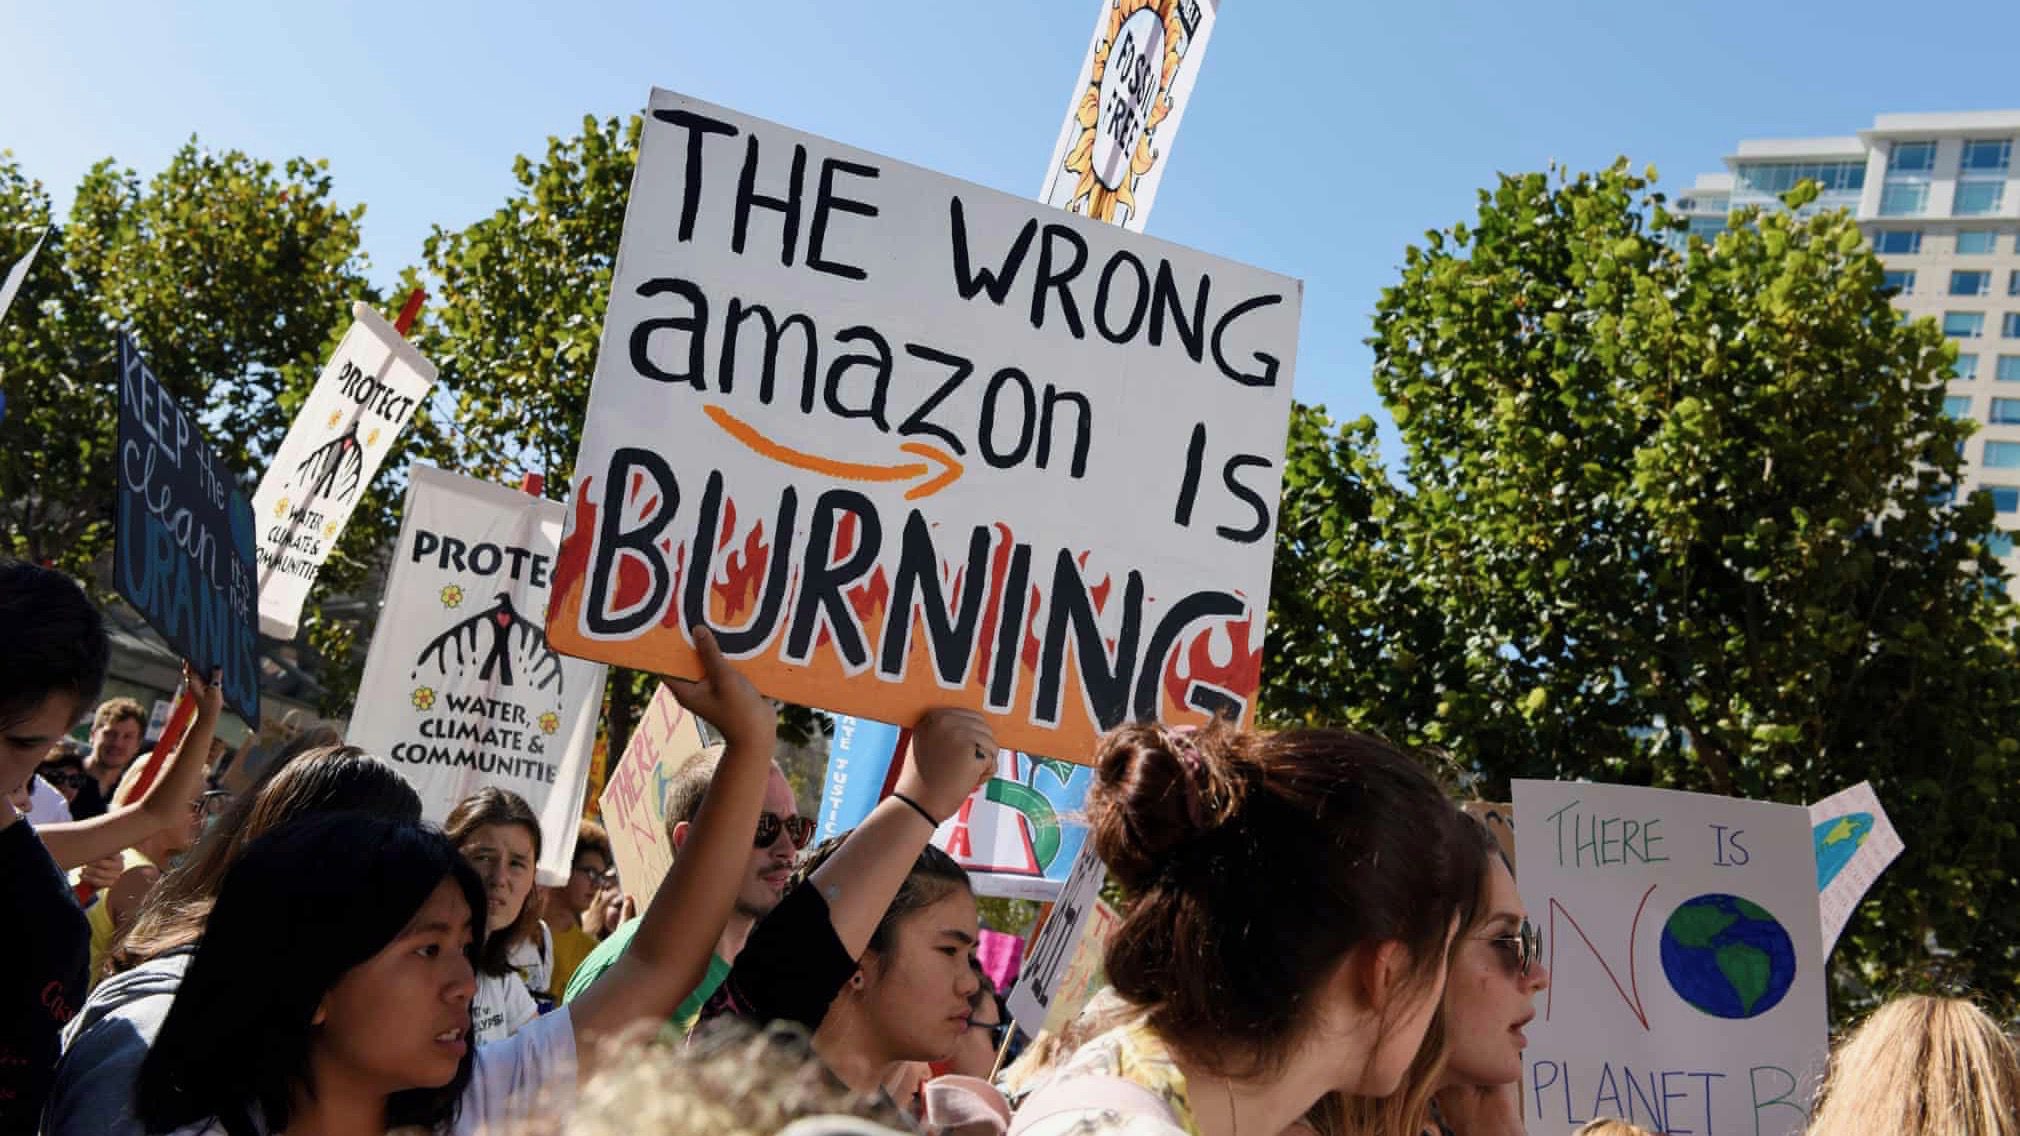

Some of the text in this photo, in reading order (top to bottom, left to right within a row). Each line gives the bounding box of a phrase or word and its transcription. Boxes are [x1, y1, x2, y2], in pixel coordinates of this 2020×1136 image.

[654, 108, 1282, 387] THE WRONG
[123, 337, 225, 511] KEEP the
[338, 357, 414, 425] PROTECT
[630, 277, 1273, 543] amazon IS
[268, 525, 312, 553] CLIMATE
[411, 529, 554, 588] PROTE
[120, 489, 258, 719] URANUS
[583, 445, 1251, 733] BURNING
[419, 718, 545, 755] CLIMATE &
[446, 694, 531, 728] WATER,
[1546, 801, 1670, 868] THERE
[1709, 825, 1750, 867] IS
[1533, 1060, 1809, 1136] PLANET B
